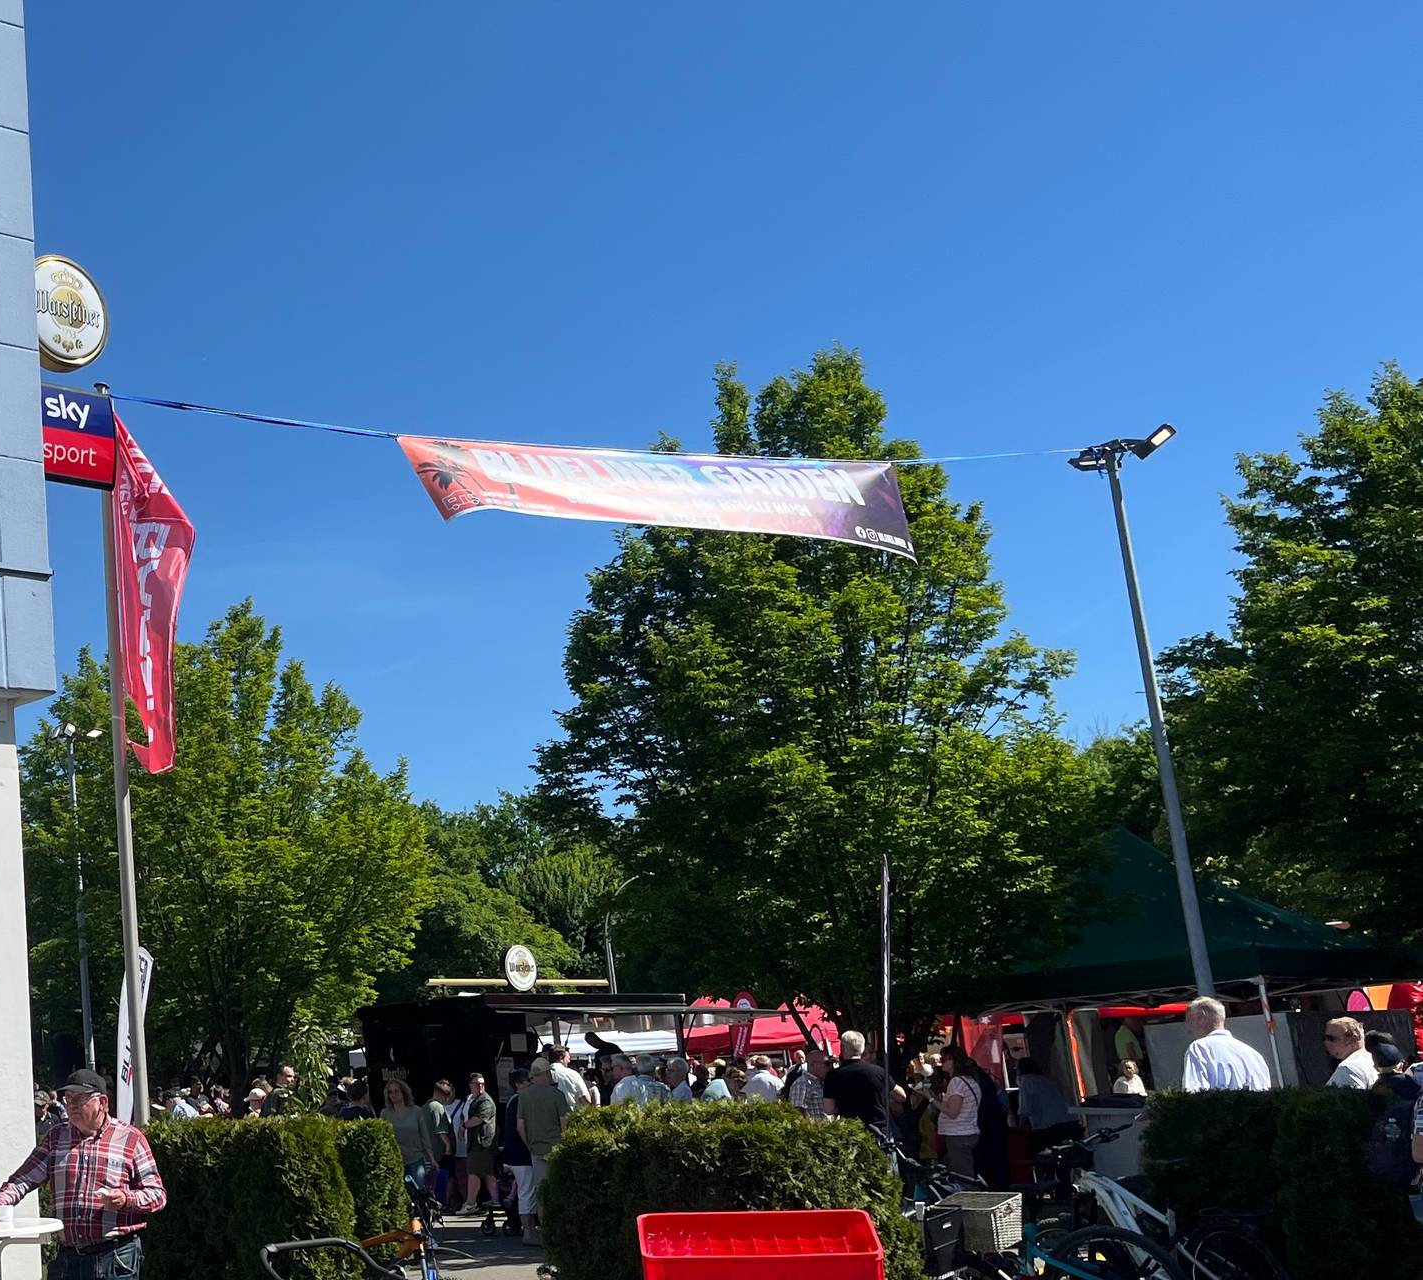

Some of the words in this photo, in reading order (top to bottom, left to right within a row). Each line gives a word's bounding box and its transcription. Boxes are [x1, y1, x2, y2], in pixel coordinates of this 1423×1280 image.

[36, 289, 100, 328] Warsteiner
[45, 394, 90, 429] sky
[43, 442, 97, 467] sport
[700, 465, 866, 506] GARDEN
